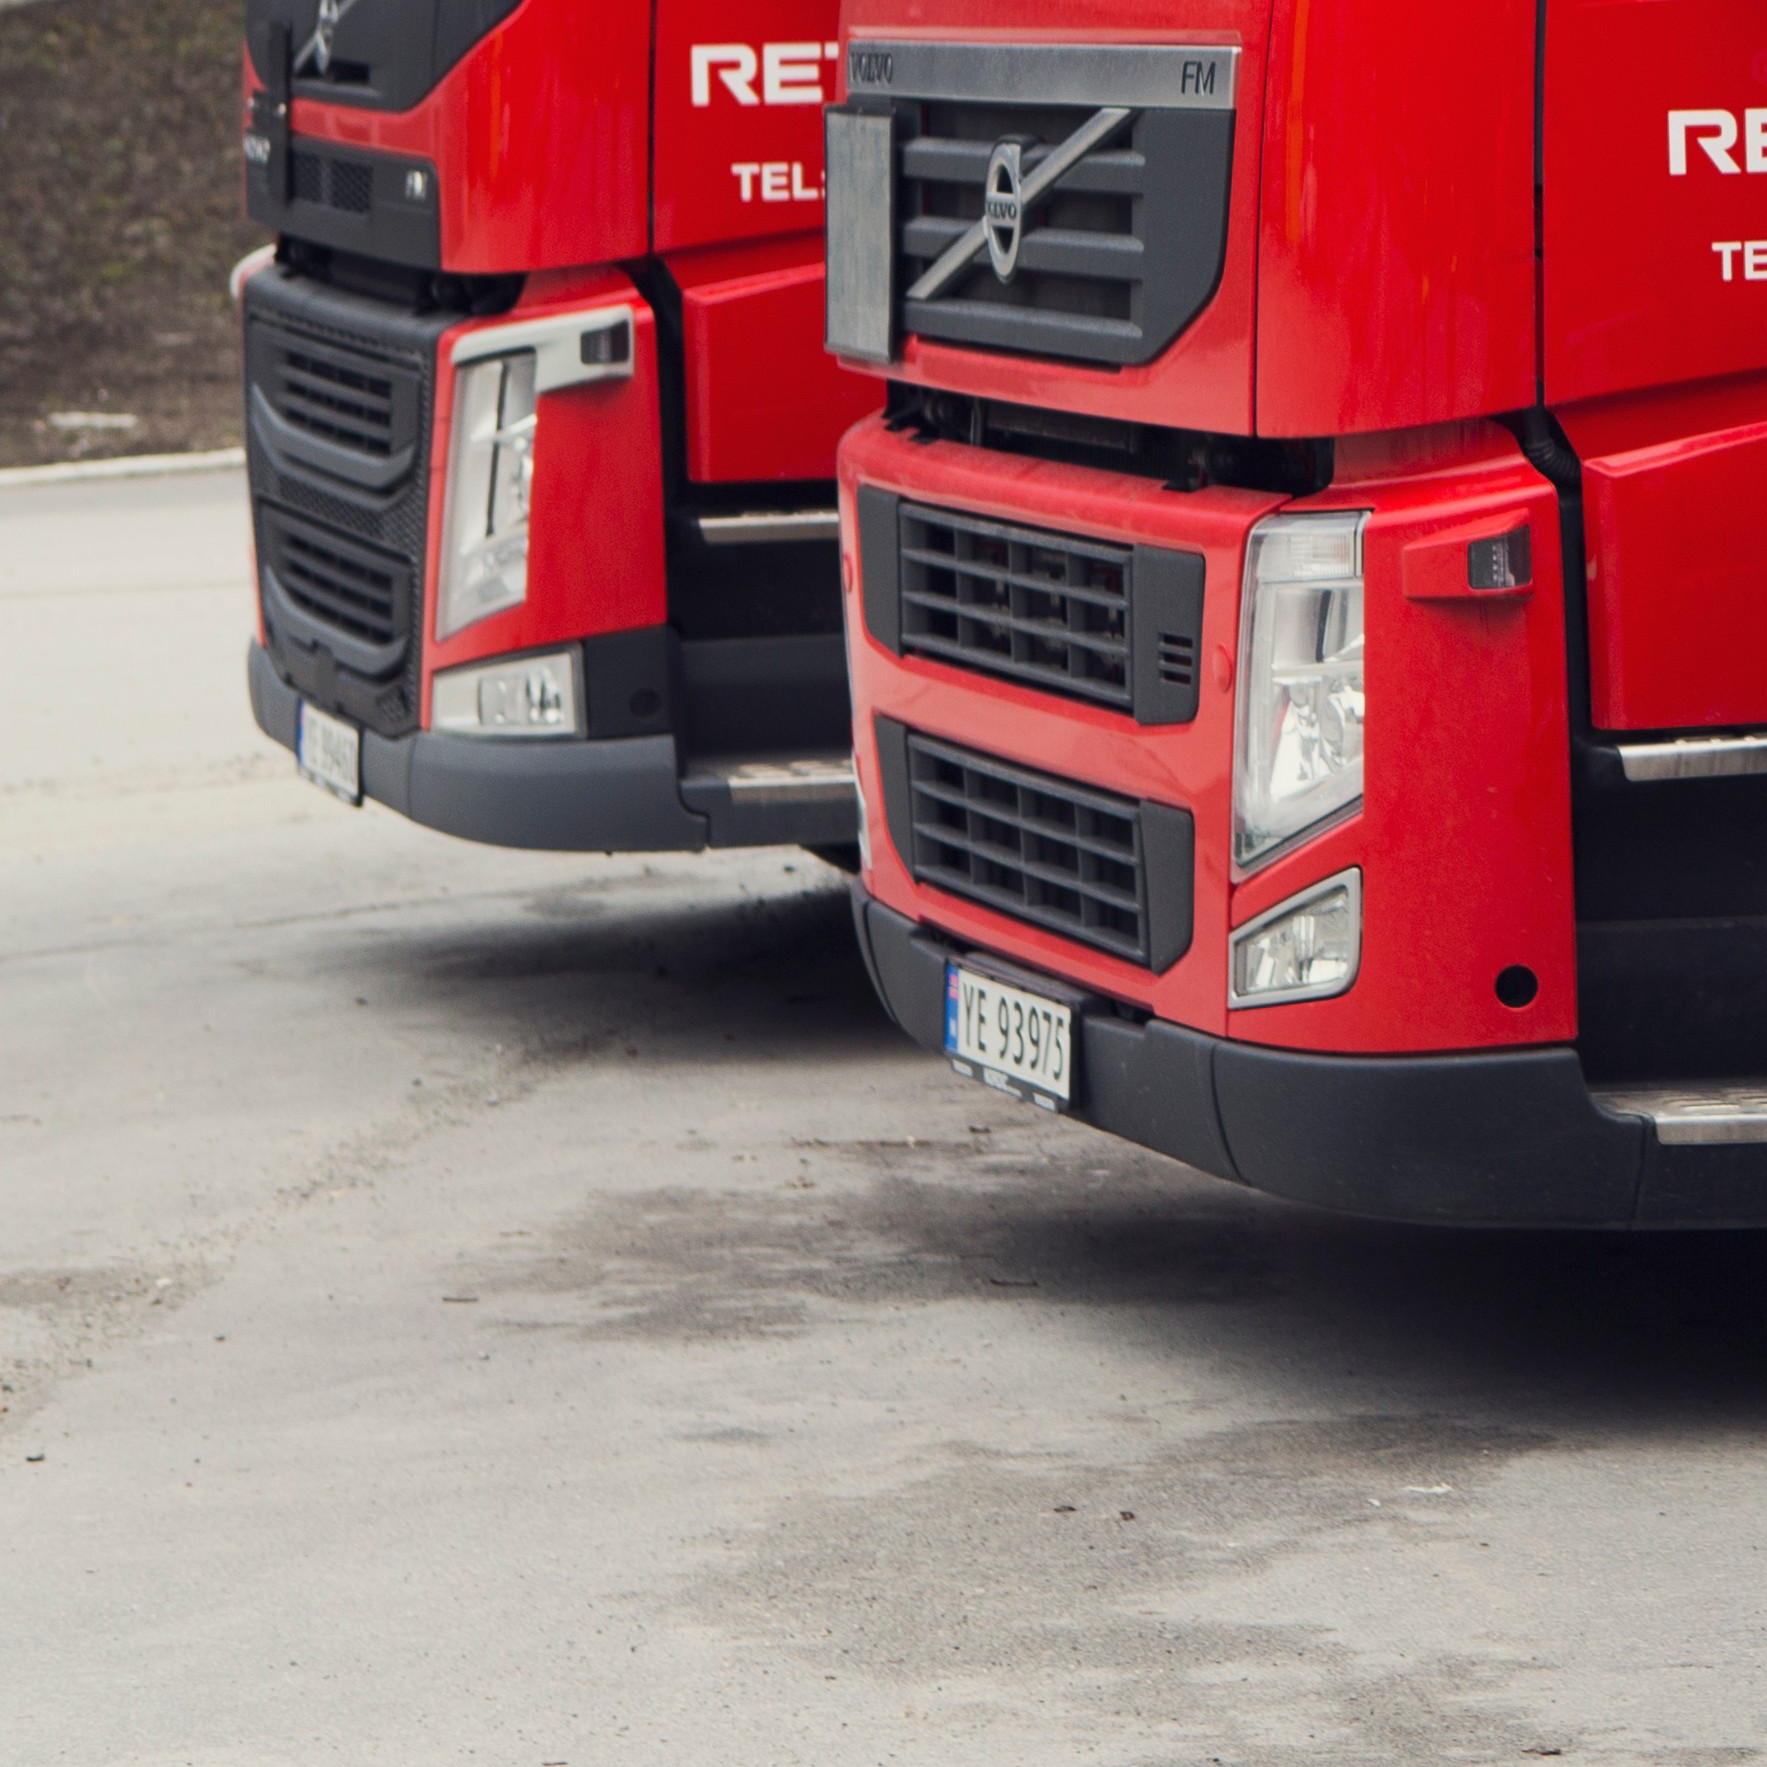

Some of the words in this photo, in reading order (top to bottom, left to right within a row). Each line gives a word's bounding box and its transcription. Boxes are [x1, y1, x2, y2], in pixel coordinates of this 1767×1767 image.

[691, 41, 839, 108] RE
[851, 53, 893, 84] VOLVO
[1181, 60, 1216, 96] FM
[963, 982, 986, 1053] YE
[998, 995, 1064, 1081] 93975
